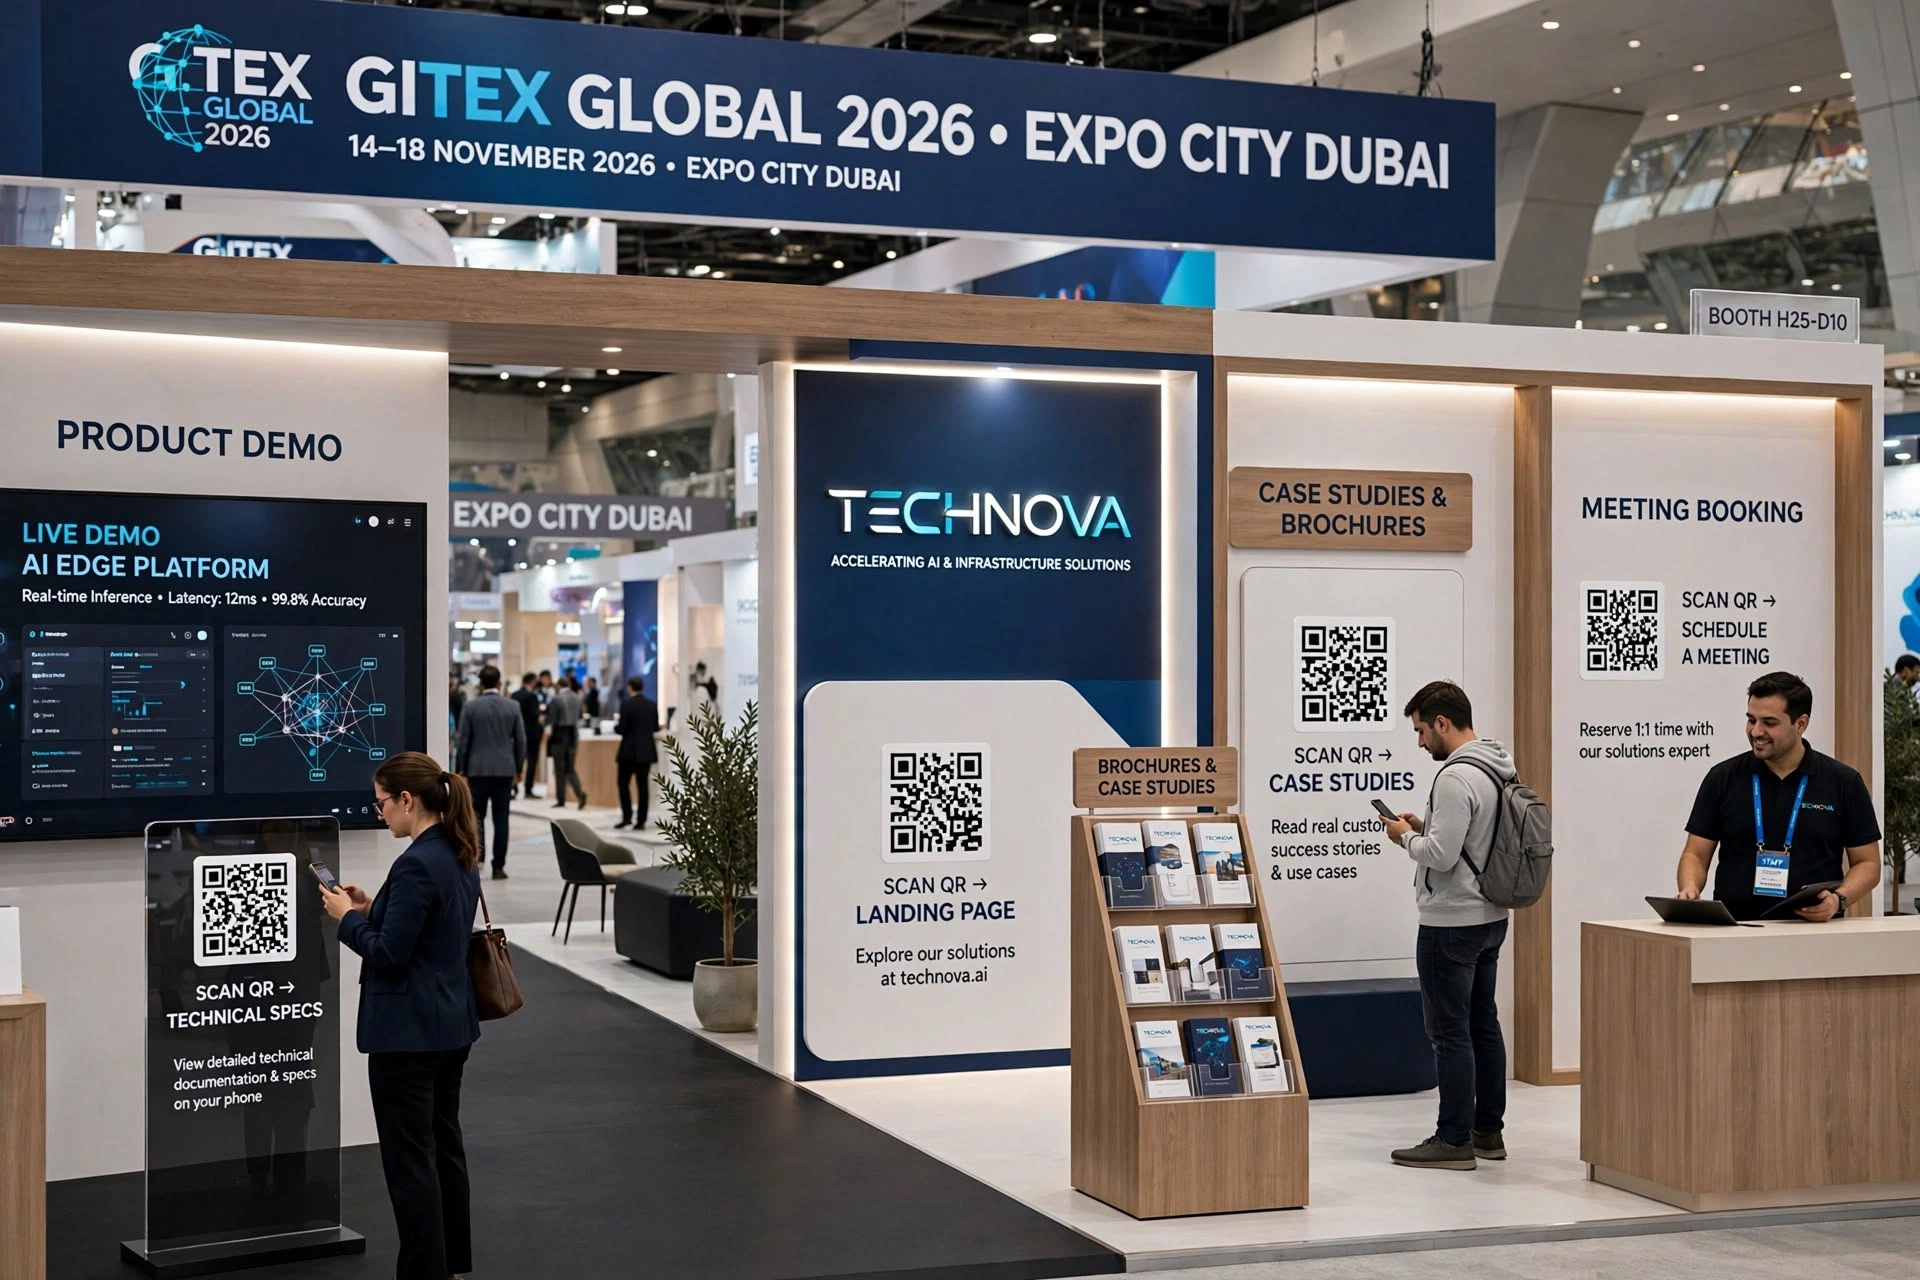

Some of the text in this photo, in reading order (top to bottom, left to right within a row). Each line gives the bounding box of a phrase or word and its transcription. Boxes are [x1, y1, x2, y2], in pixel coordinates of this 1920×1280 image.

[203, 96, 314, 125] GLOBAL
[346, 56, 1448, 189] GITEX GLOBAL 2026 EXPO CITY DUBAI
[204, 122, 271, 149] 2026
[435, 140, 585, 171] NOVEMBER
[593, 151, 655, 175] 2026
[688, 157, 754, 182] EXPO
[762, 161, 818, 186] CITY
[826, 166, 900, 191] DUBAI
[1710, 307, 1847, 330] BOOTH H25-D10
[58, 420, 341, 461] PRODUCT DEMO
[1259, 482, 1446, 507] CASE STUDIES &
[454, 501, 691, 531] EXPO CITY DUBAI
[826, 488, 1132, 539] TECHNOVA
[1583, 497, 1802, 523] MEETING BOOKING
[24, 523, 160, 546] LIVE DEMO
[1282, 514, 1425, 536] BROCHURES
[22, 554, 268, 579] AI EDGE PLATFORM
[831, 555, 1130, 571] ACCELERATING AI & INFRASTRUCTURE SOLUTIONS
[23, 589, 366, 609] Real-time Inference Latency: 12ms 99.8% Accuracy
[1683, 591, 1757, 610] SCAN QR
[1682, 621, 1767, 638] SCHEDULE
[1682, 648, 1769, 664] A MEETING
[1580, 721, 1713, 736] Reserve 1:1 time with
[1295, 747, 1372, 764] SCAN QR
[1580, 743, 1710, 760] our solutions expert
[1099, 758, 1216, 774] BROCHURES &
[1099, 779, 1215, 795] CASE STUDIES
[1270, 772, 1414, 792] CASE STUDIES
[1272, 818, 1307, 834] Read
[1313, 818, 1338, 833] real
[1272, 840, 1380, 857] success stories
[1271, 865, 1357, 880] & use cases
[884, 877, 966, 894] SCAN QR
[857, 901, 1015, 924] LANDING PAGE
[856, 943, 1015, 965] Explore our solutions
[881, 966, 987, 986] at technova.ai
[197, 981, 273, 1000] SCAN QR
[167, 1002, 323, 1028] TECHNICAL SPECS
[174, 1047, 313, 1071] View detailed technical
[173, 1069, 316, 1090] documentation & specs
[174, 1092, 262, 1111] on your phone
